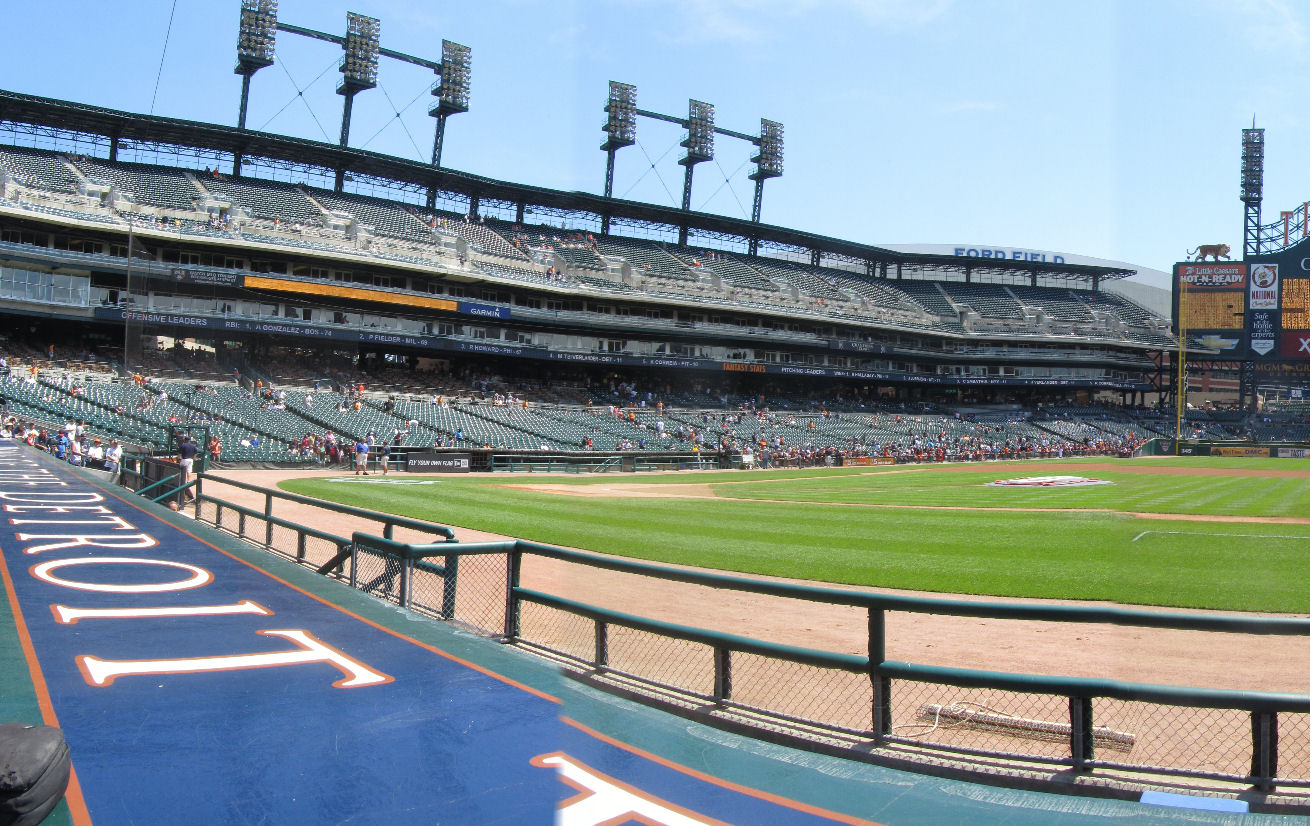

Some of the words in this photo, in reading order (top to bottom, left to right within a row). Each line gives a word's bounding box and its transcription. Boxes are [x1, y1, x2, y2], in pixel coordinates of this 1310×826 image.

[954, 248, 1006, 260] FORD
[1196, 267, 1213, 275] Little
[1180, 275, 1245, 283] HOT-N-READY
[1251, 290, 1277, 300] NATIONAL
[471, 307, 500, 317] GARMIN
[121, 311, 166, 323] OFFENSIVE
[168, 315, 208, 326] LEADERS
[722, 362, 748, 372] FANTASY
[750, 363, 766, 373] STATS
[1255, 363, 1280, 372] MGM
[0, 491, 395, 687] DETROIT
